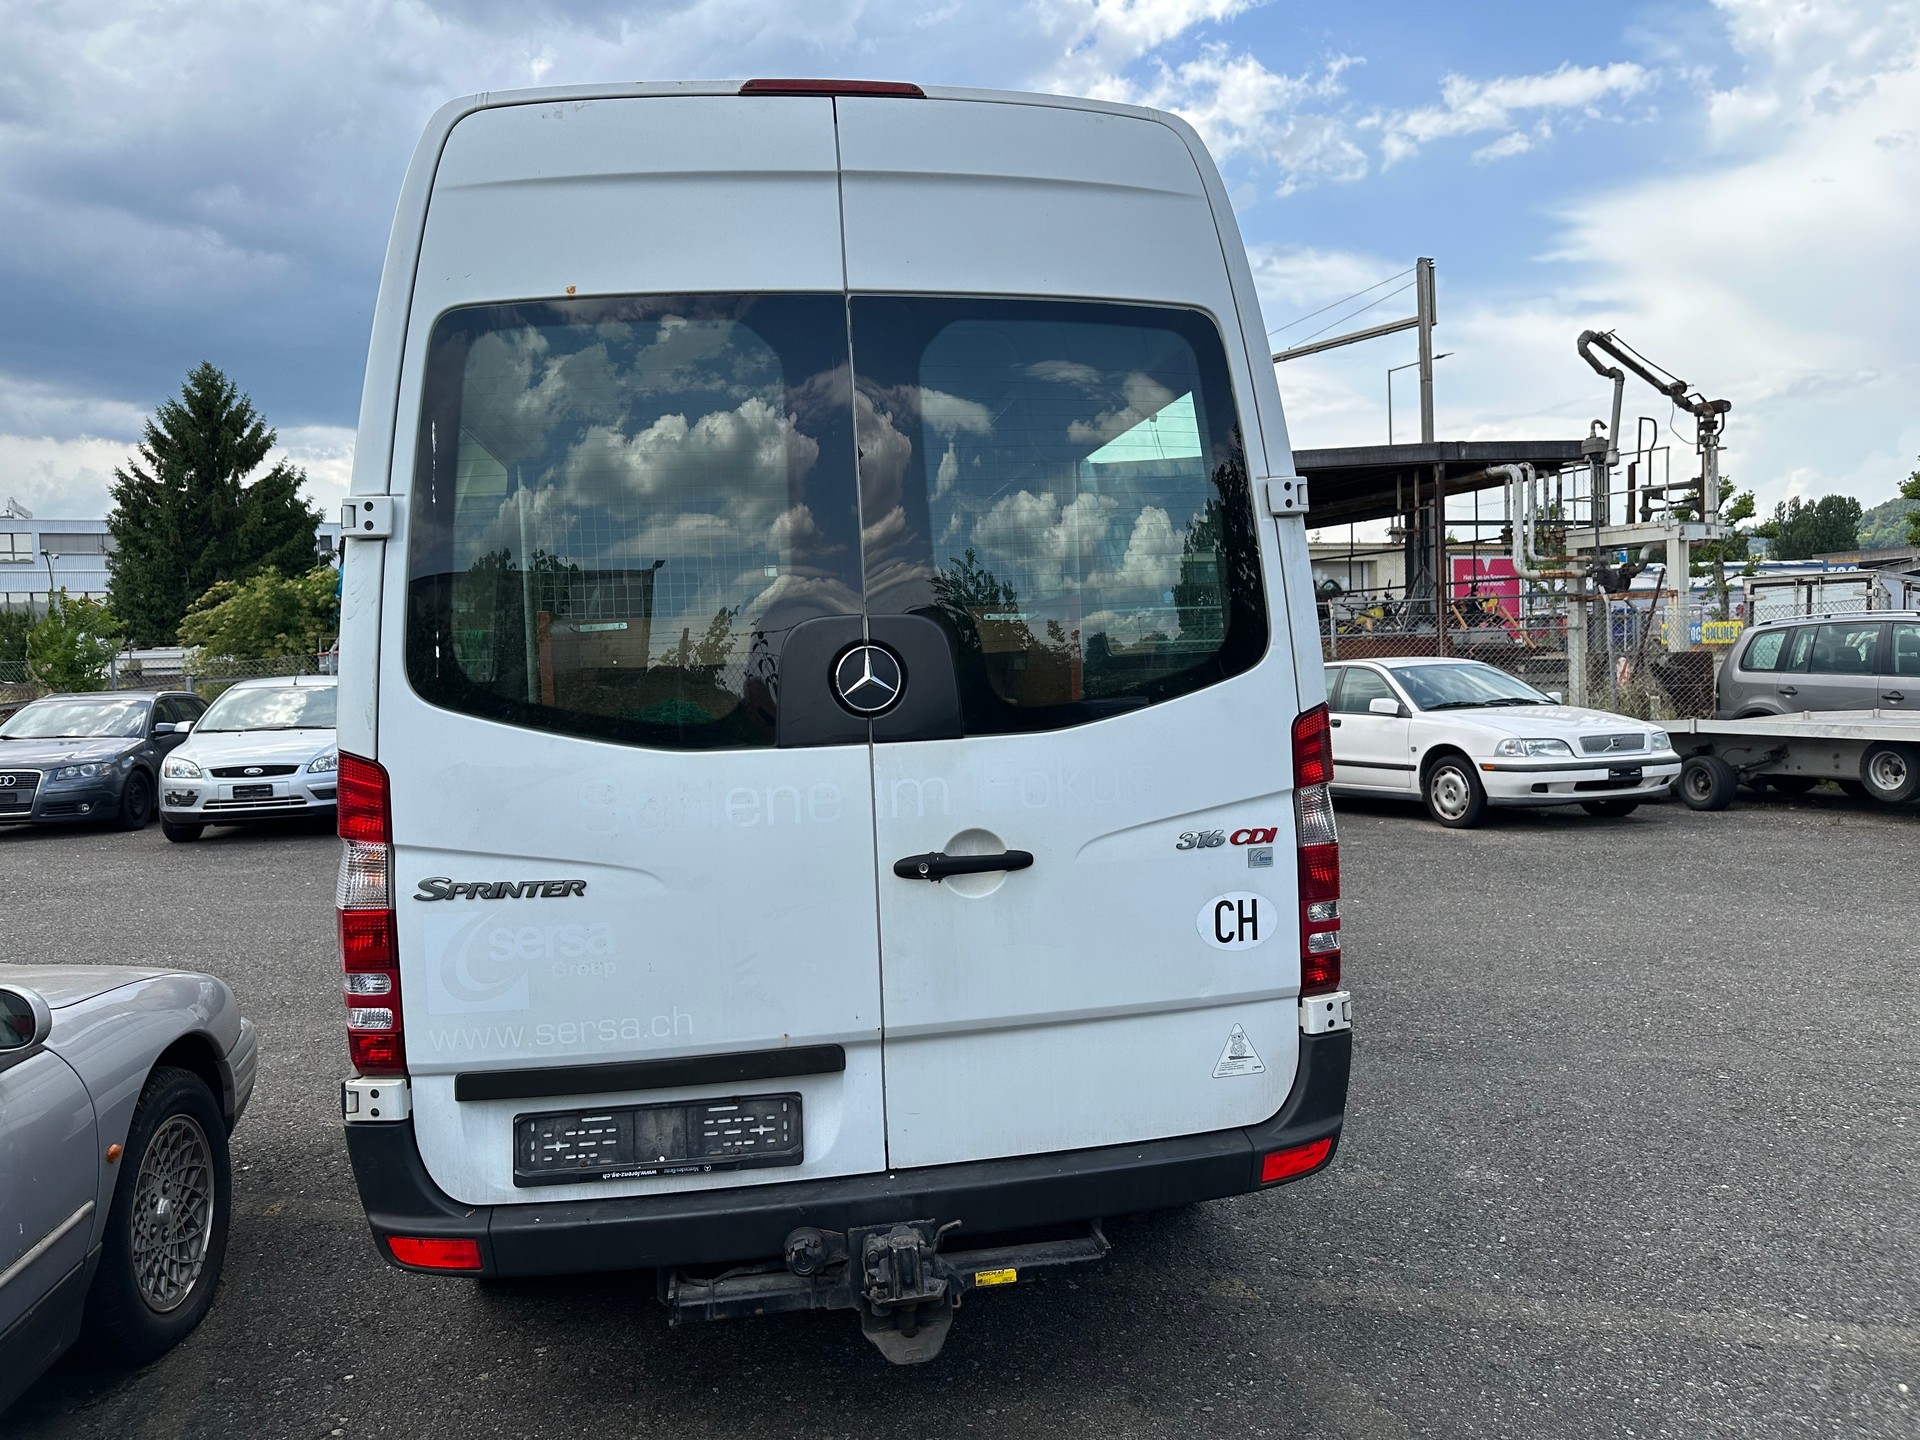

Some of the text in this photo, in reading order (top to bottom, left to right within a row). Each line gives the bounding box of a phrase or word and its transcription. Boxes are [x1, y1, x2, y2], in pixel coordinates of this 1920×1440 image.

[875, 765, 951, 821] im
[1176, 827, 1278, 850] 316 CDI
[412, 876, 588, 902] SPRINTER
[488, 921, 616, 961] sersa
[1214, 898, 1258, 943] CH
[428, 1005, 694, 1052] www.sersa.ch
